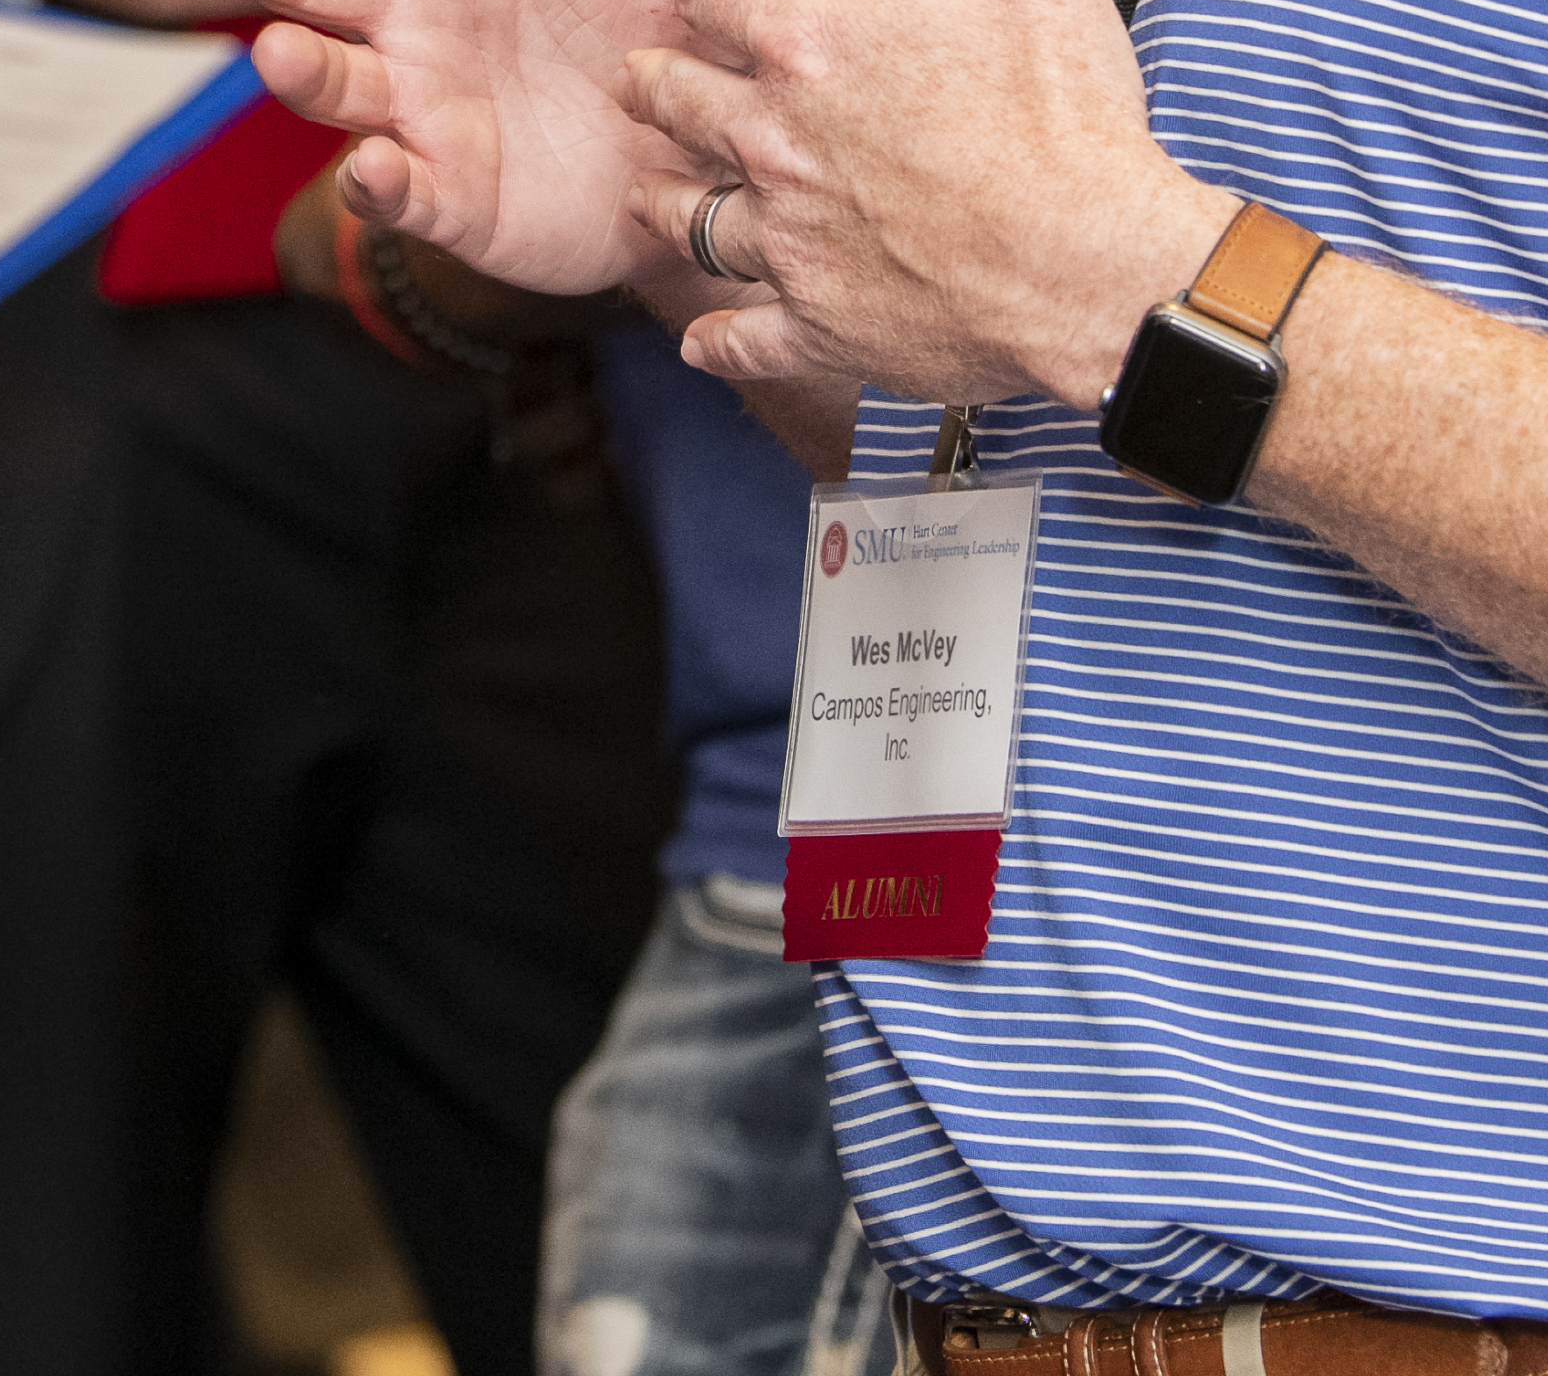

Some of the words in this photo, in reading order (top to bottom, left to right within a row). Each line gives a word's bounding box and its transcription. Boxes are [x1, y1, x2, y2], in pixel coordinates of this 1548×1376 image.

[851, 635, 890, 666] Wes
[896, 629, 957, 667] McVey
[811, 692, 883, 726] Campos
[888, 682, 991, 723] Engineering,
[884, 732, 911, 761] Inc.
[821, 874, 943, 920] ALUMNI
